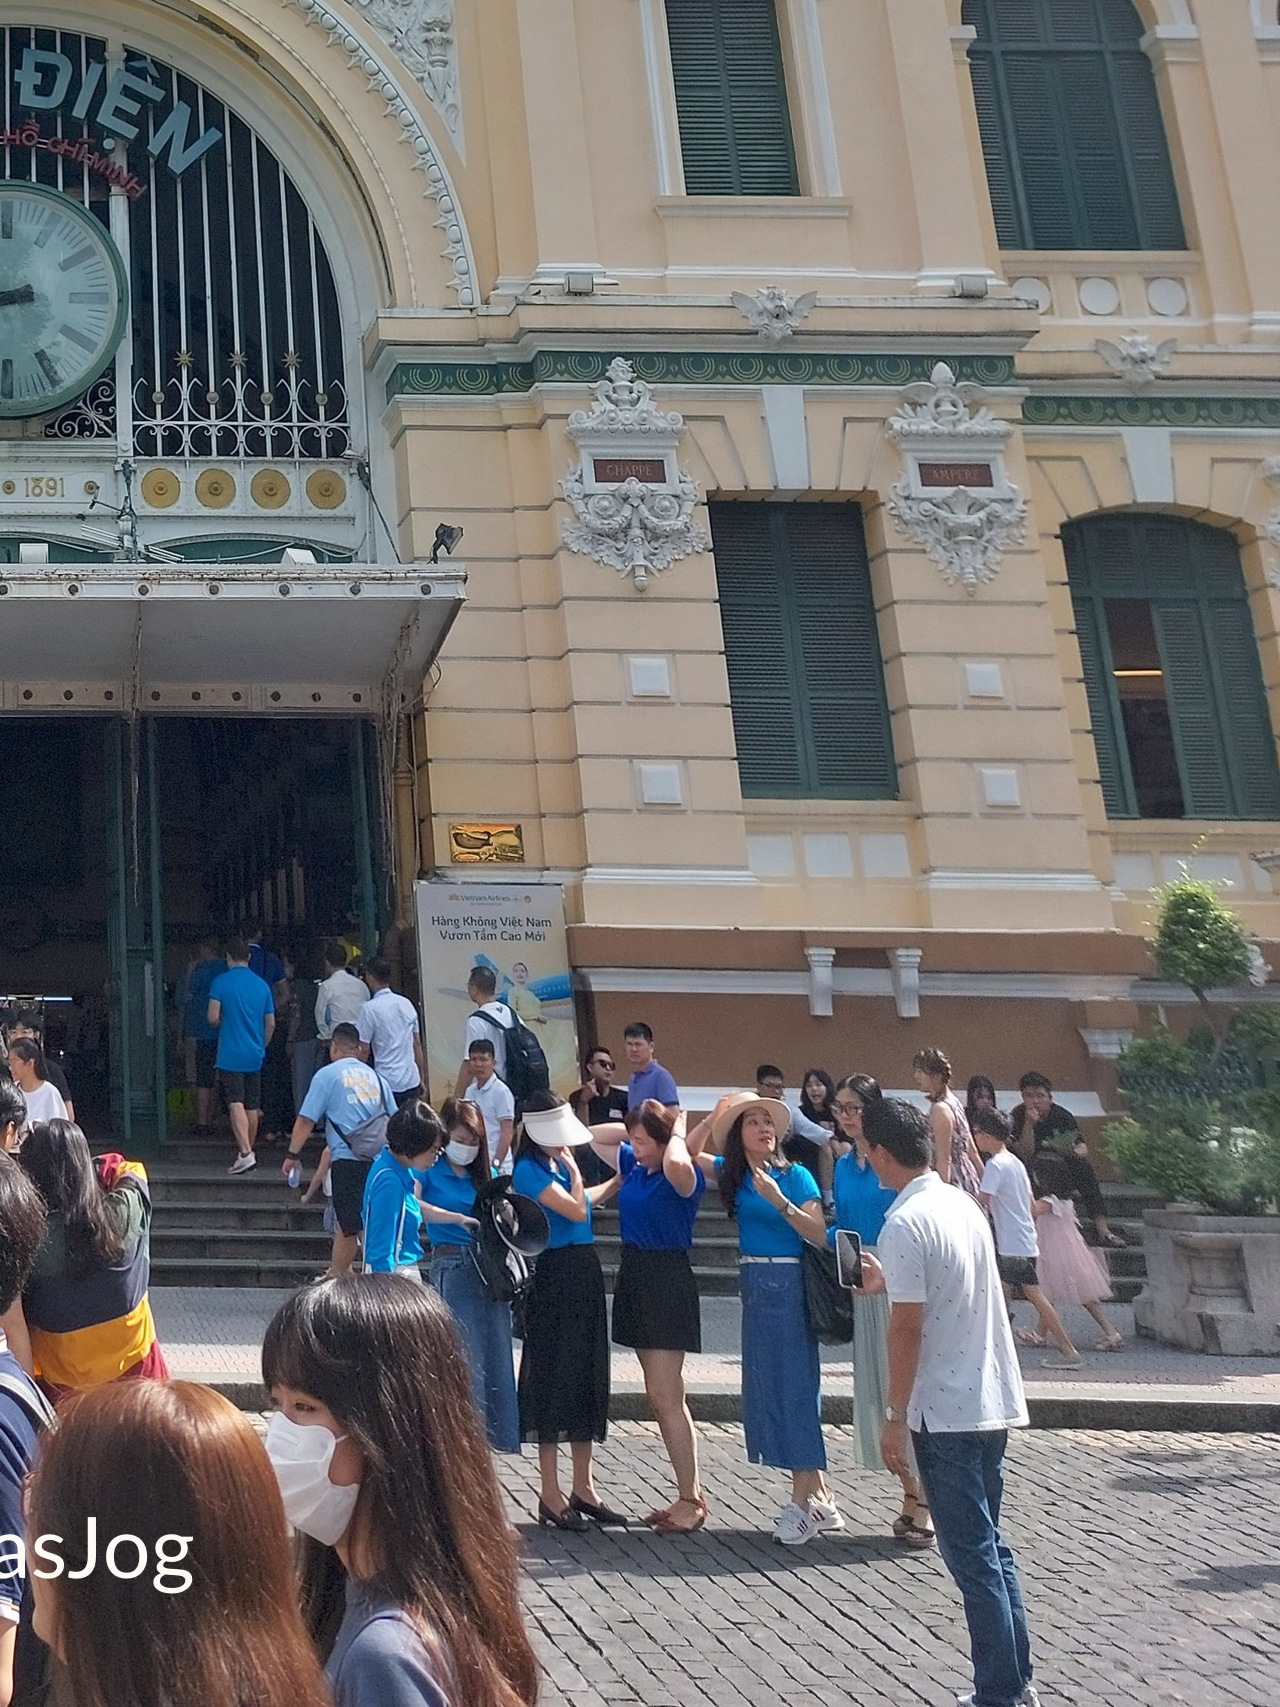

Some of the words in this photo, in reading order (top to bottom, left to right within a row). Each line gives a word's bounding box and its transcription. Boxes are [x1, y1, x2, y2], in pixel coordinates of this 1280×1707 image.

[14, 47, 223, 176] ĐIỆN
[89, 151, 148, 198] MINH
[606, 464, 653, 476] CHAPPE
[24, 476, 66, 498] 1891
[431, 916, 460, 929] Hàng
[463, 916, 498, 929] Không
[500, 917, 524, 930] Việt
[526, 917, 552, 928] Nam
[500, 931, 522, 941] Cao
